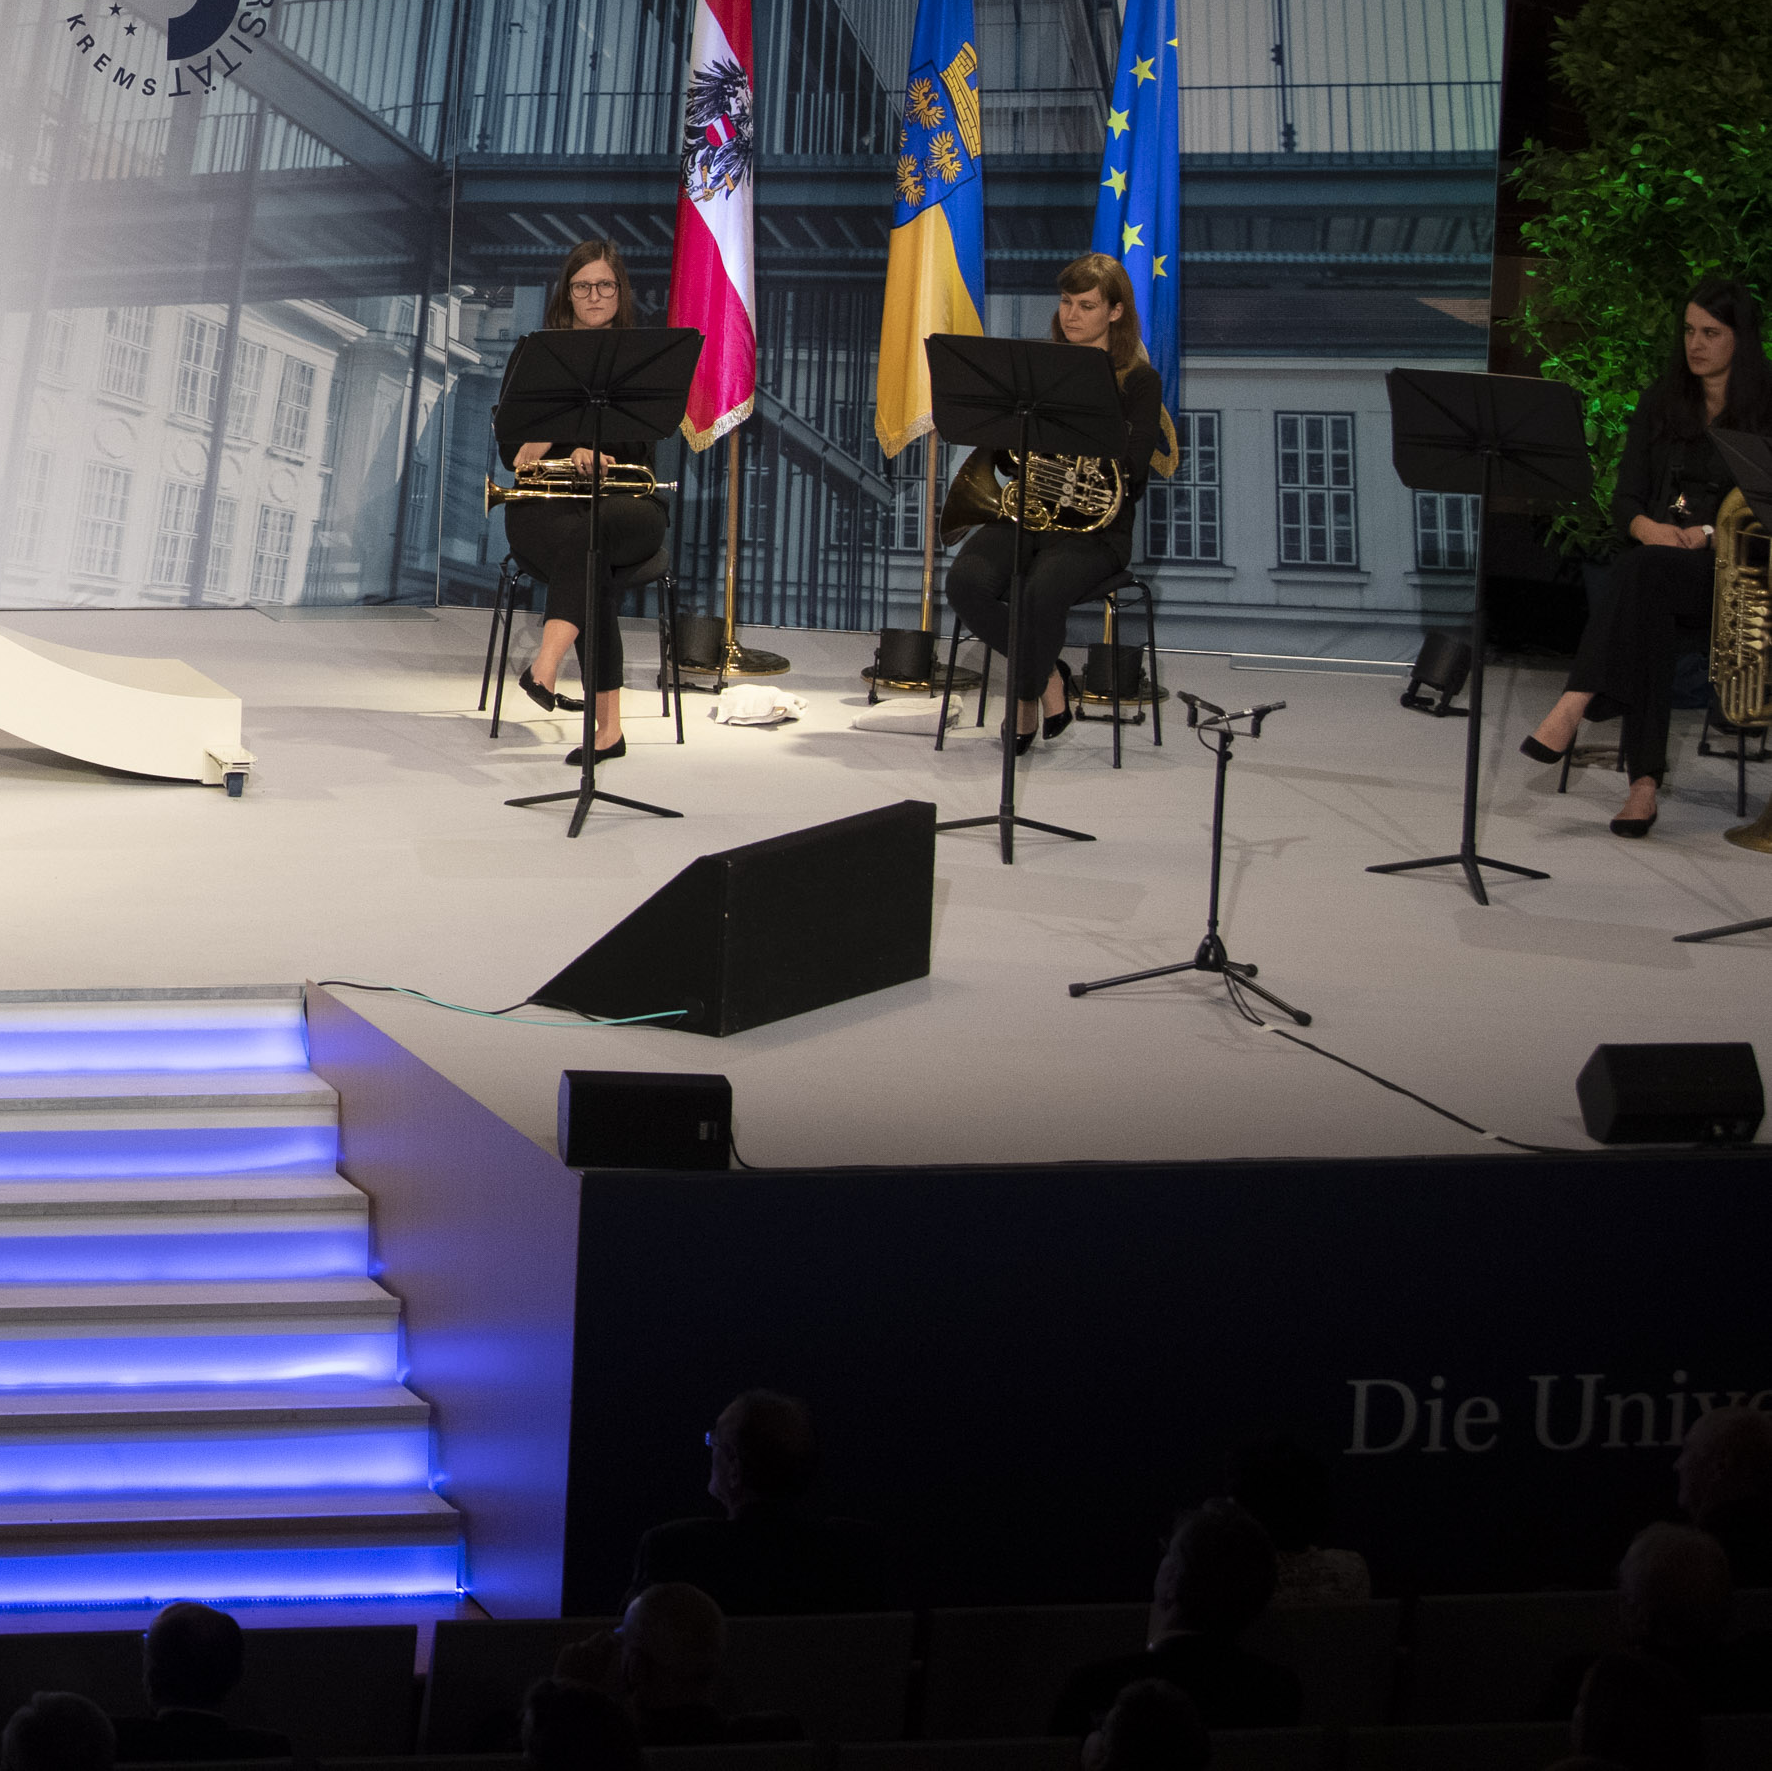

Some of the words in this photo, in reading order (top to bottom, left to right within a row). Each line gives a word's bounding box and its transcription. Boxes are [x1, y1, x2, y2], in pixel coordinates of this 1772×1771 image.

[67, 14, 156, 95] KREMS
[1343, 1374, 1500, 1455] Die
[1528, 1369, 1772, 1451] Uni
